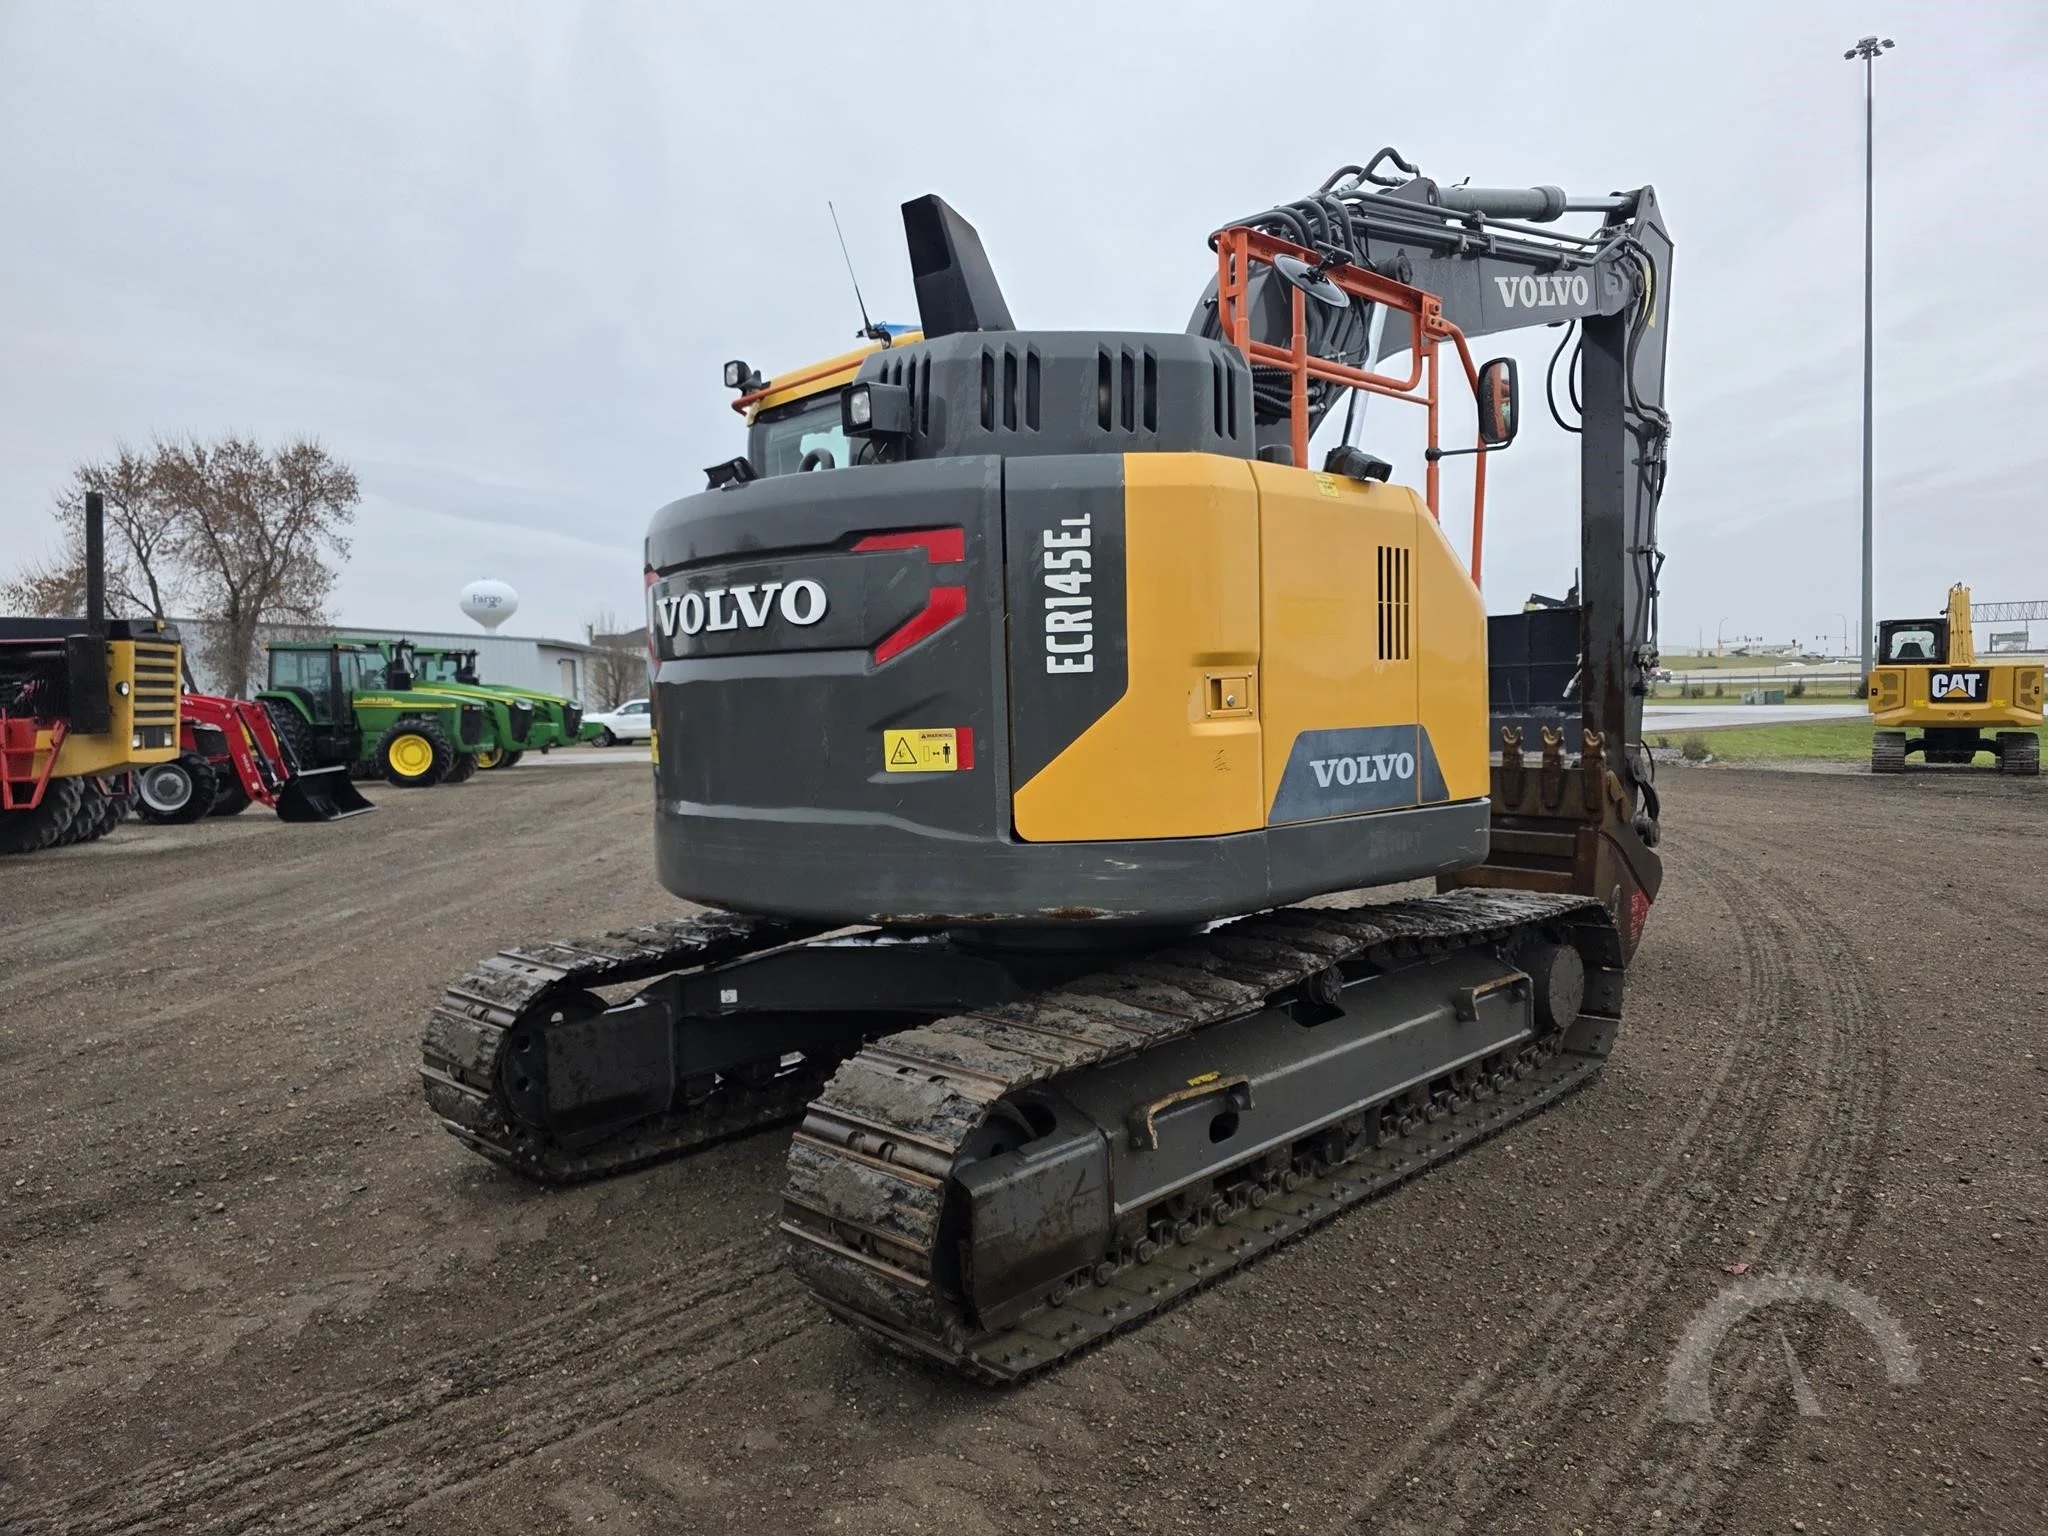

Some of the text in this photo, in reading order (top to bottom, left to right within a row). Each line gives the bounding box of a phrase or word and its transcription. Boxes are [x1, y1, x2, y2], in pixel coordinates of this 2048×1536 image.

[1494, 275, 1589, 308] VOLVO
[472, 593, 503, 609] Fargo
[656, 579, 827, 637] VOLVO
[1931, 673, 1980, 698] CAT
[1309, 752, 1415, 788] VOLVO
